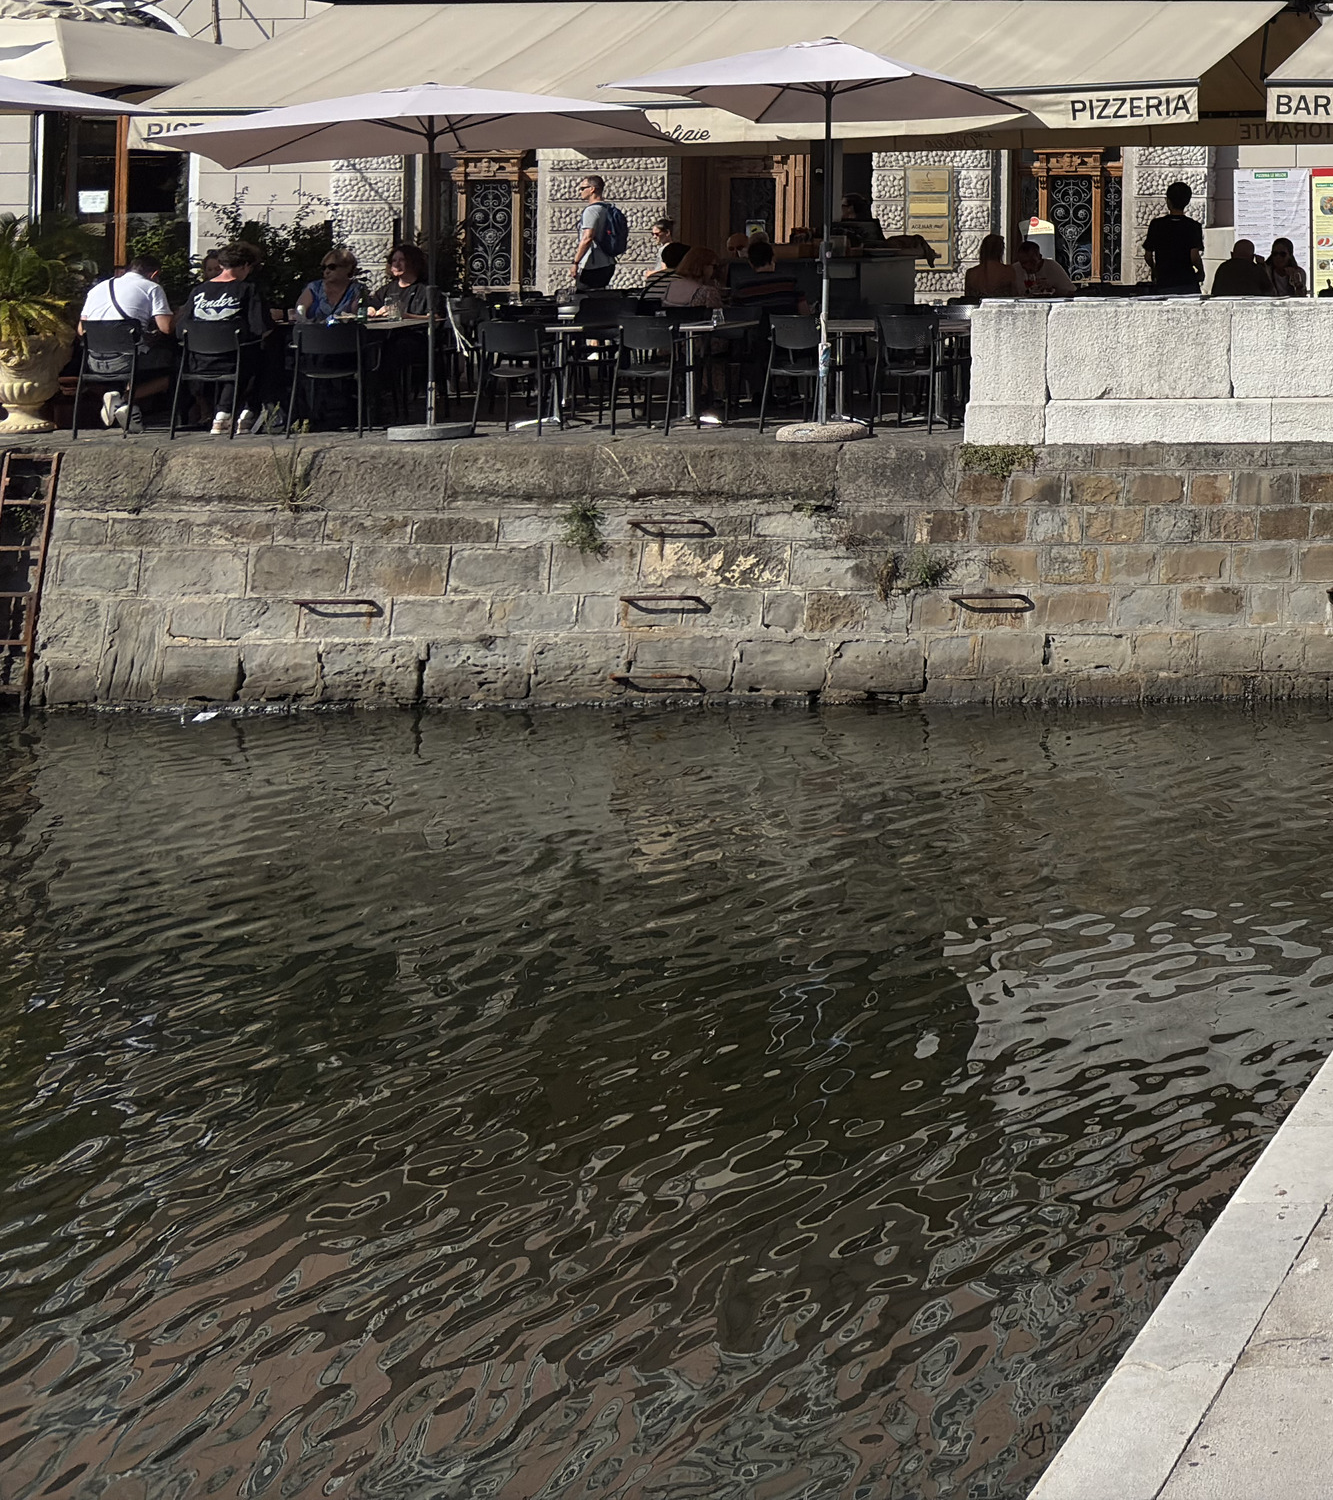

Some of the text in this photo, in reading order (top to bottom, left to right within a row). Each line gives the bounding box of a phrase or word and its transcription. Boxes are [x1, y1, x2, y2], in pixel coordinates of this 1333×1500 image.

[1070, 94, 1191, 121] PIZZERIA
[1275, 94, 1331, 116] BAR
[193, 292, 240, 311] Fender
